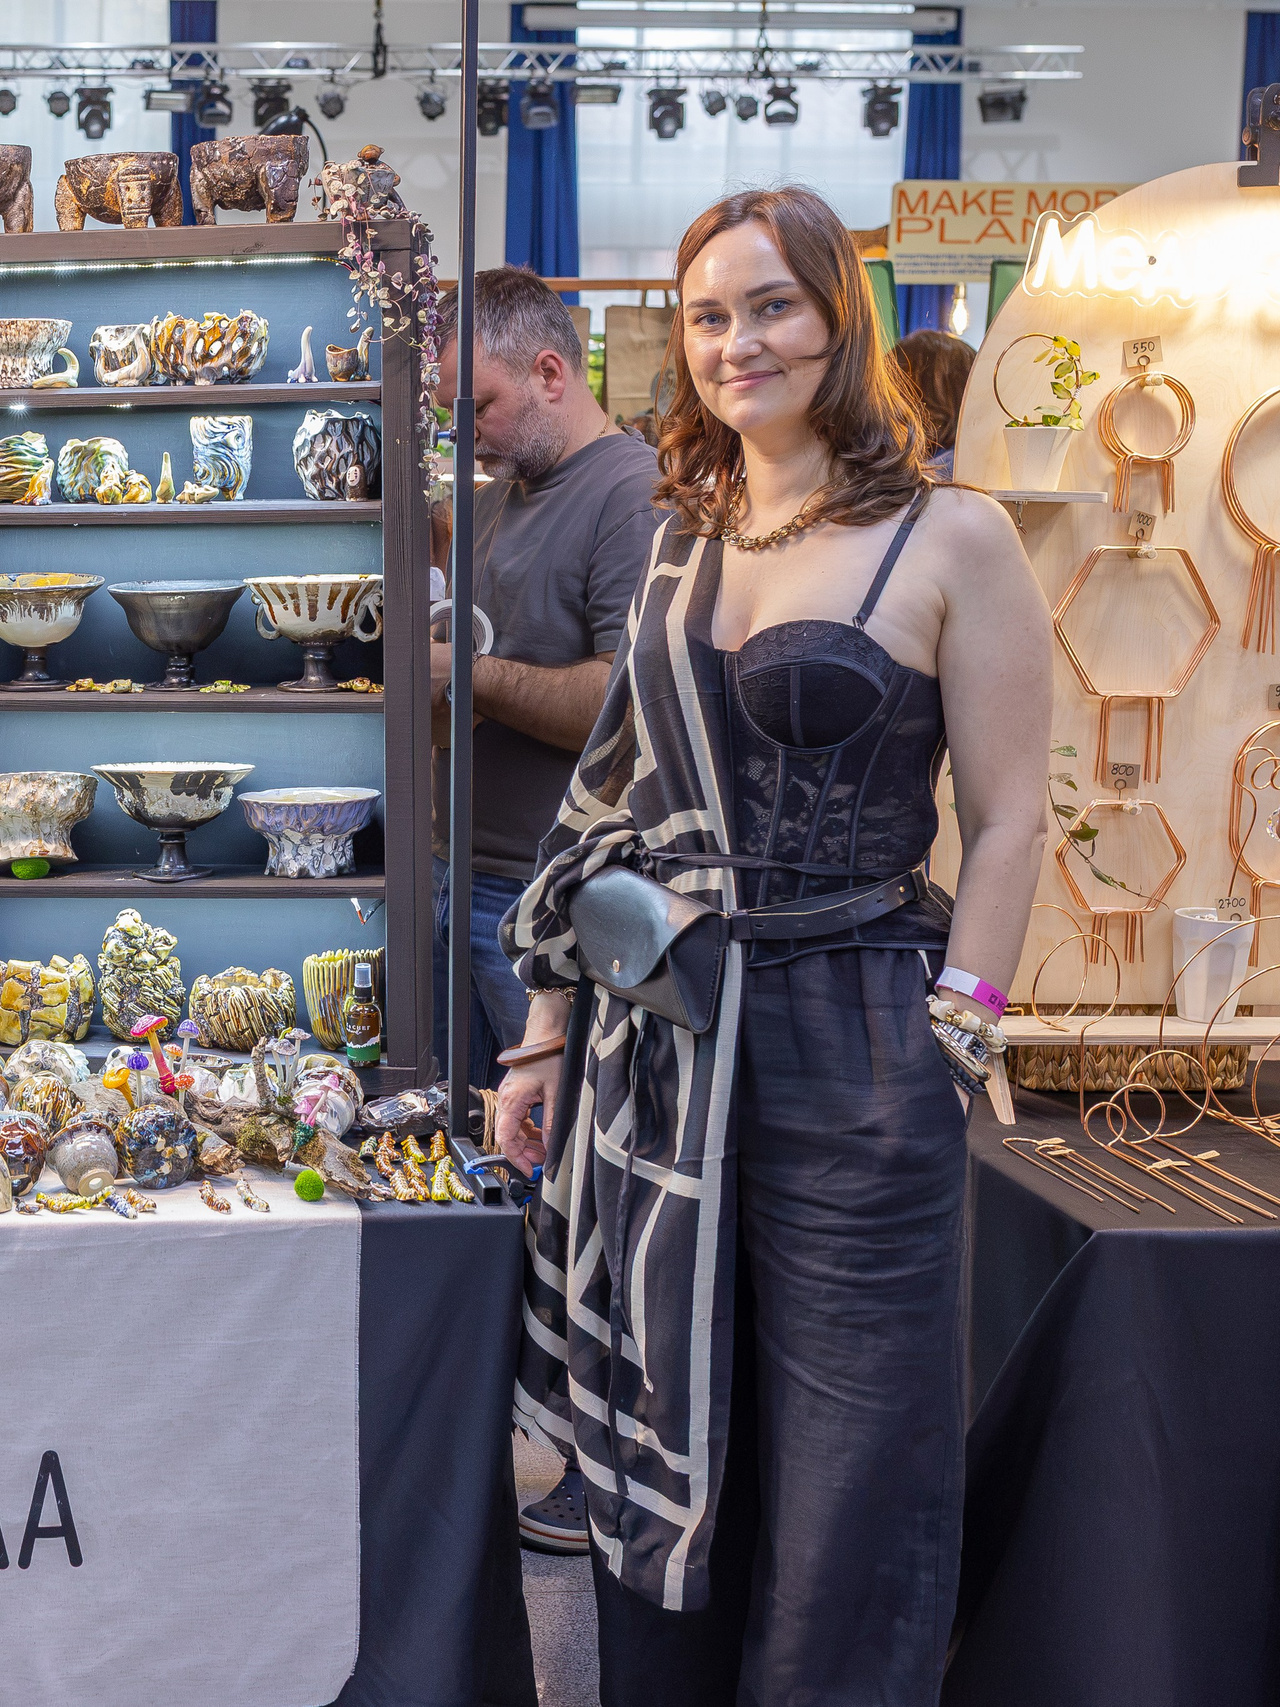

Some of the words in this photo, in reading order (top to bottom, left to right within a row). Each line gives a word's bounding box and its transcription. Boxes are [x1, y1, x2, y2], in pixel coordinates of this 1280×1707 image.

[896, 189, 1015, 216] MAKE
[1132, 341, 1156, 355] 550
[1136, 512, 1153, 527] 1000
[1111, 763, 1135, 777] 800
[1218, 897, 1246, 910] 2700
